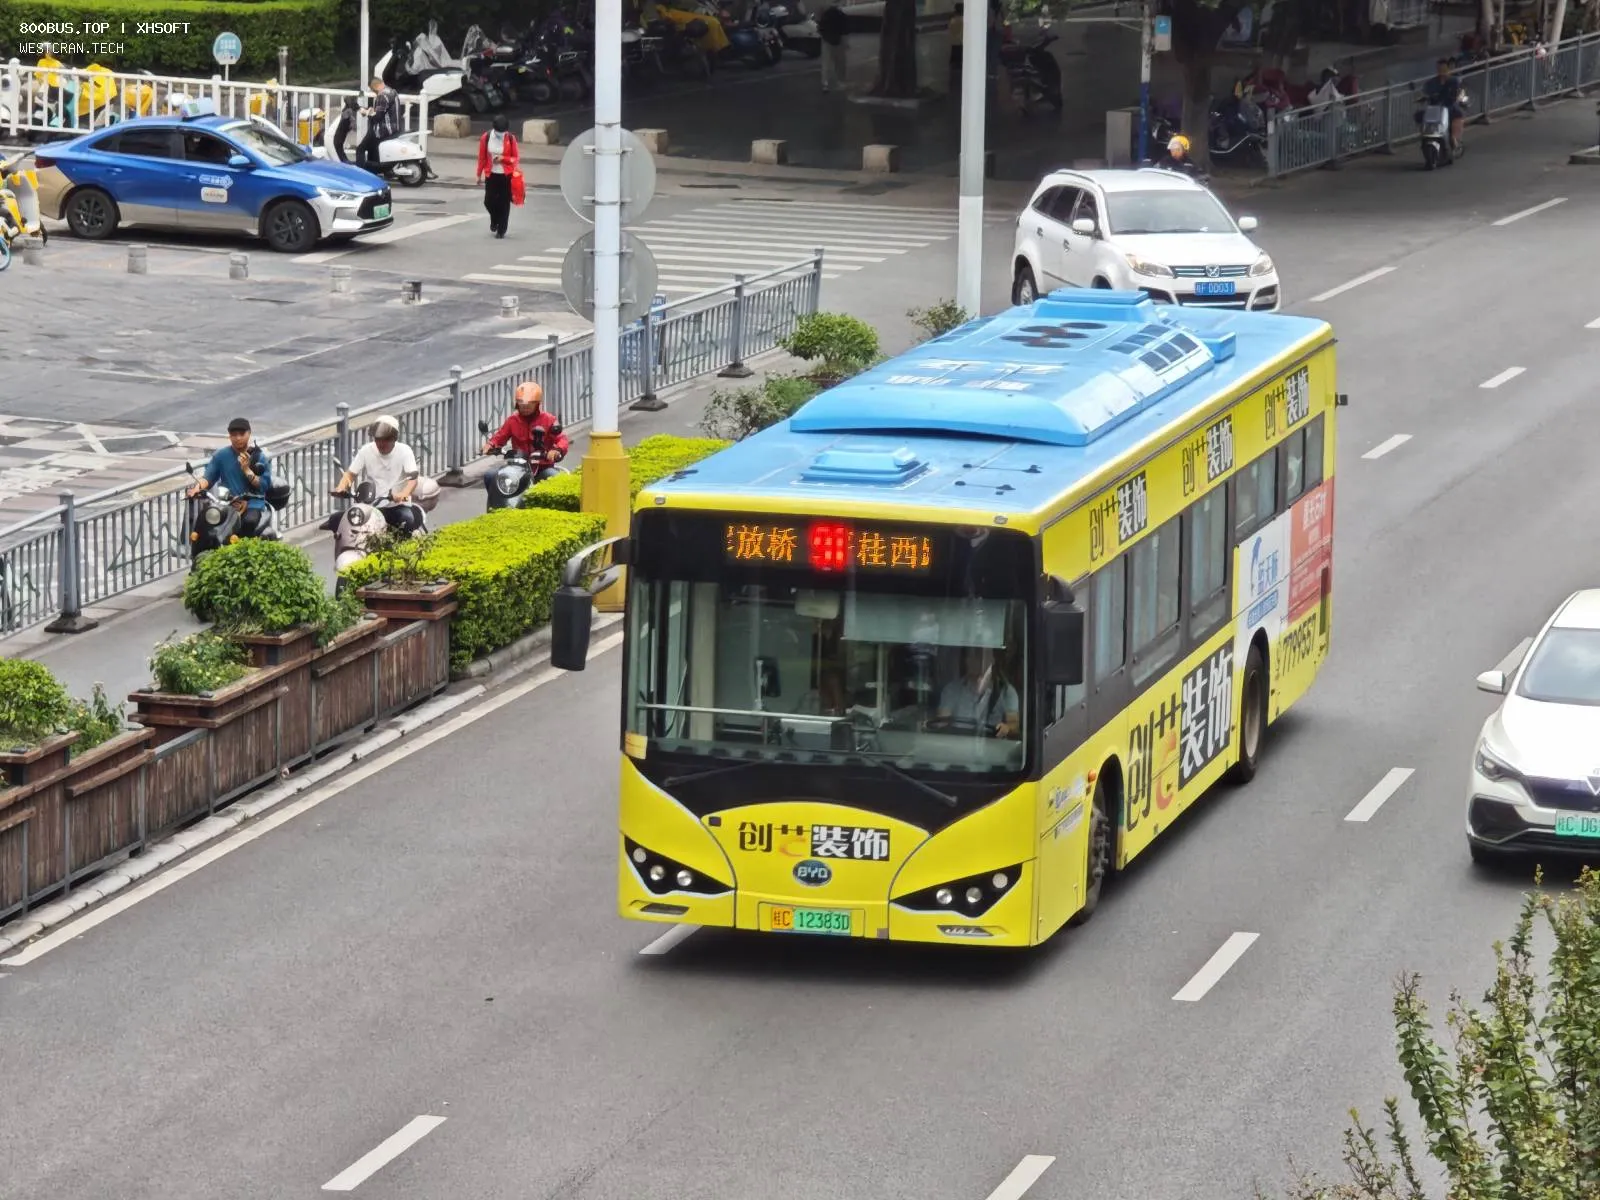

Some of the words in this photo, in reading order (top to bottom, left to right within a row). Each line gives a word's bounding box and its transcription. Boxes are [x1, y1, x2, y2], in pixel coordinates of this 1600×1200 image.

[726, 525, 798, 561] 放桥
[1127, 642, 1234, 832] 创艺装饰
[738, 821, 890, 861] 创艺装饰
[797, 865, 829, 879] BYD
[799, 910, 850, 931] 12383D
